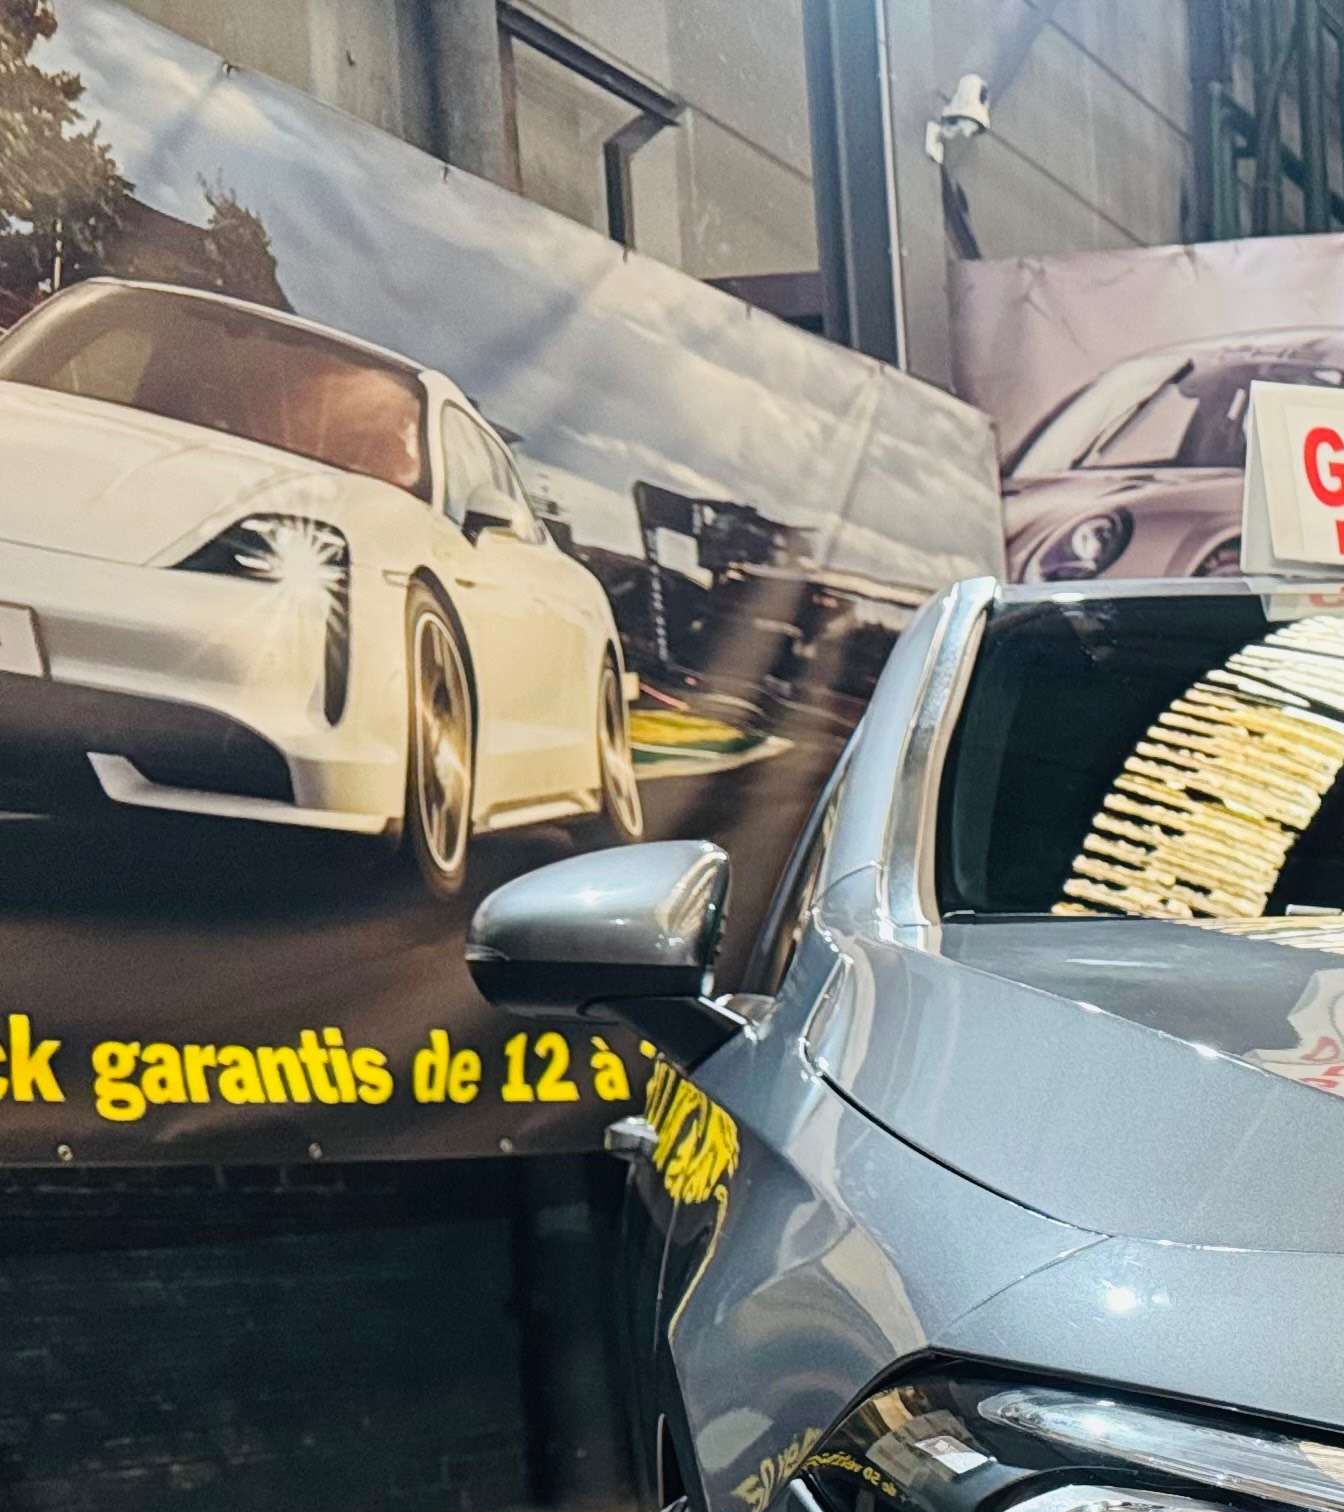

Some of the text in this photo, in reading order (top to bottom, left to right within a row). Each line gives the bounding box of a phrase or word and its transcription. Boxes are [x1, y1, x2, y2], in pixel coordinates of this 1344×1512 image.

[91, 1026, 394, 1122] garantis
[412, 1028, 482, 1104] de
[502, 1031, 580, 1103] 12
[590, 1035, 631, 1101] à
